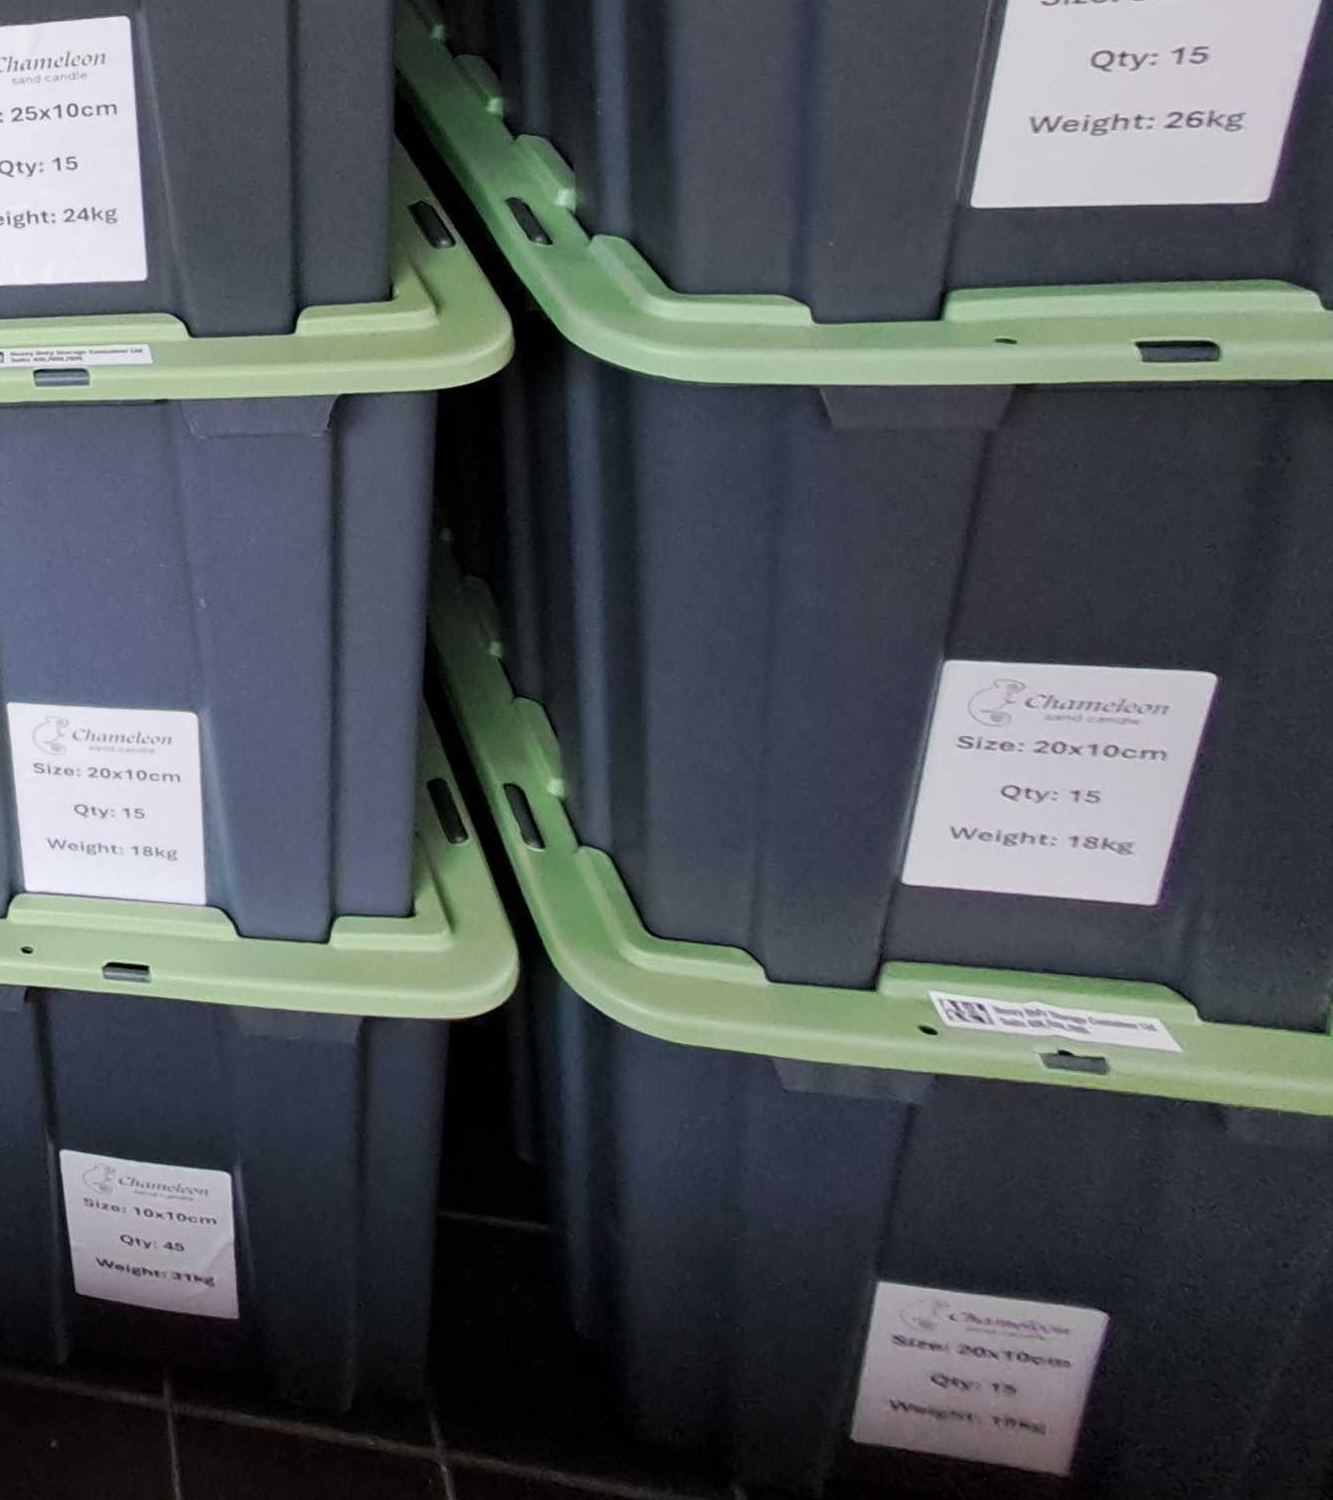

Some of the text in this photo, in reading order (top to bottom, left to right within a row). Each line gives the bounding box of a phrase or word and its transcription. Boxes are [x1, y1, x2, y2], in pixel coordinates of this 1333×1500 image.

[1090, 46, 1210, 72] Qty: 15
[11, 71, 88, 85] sand candle
[10, 103, 118, 123] 25x10cm
[1029, 110, 1246, 137] Weight: 26kg
[52, 157, 78, 172] 15
[63, 206, 118, 224] 24kg
[1025, 694, 1170, 717] Chameleon
[72, 728, 173, 746] Chameleon
[956, 735, 1168, 762] Size: 20x10cm
[33, 762, 182, 783] Size: 20x10cm
[1000, 784, 1102, 804] Qty: 15
[73, 804, 146, 820] Qty: 15
[47, 837, 178, 862] Weight: 18kg
[949, 825, 1135, 856] Weight: 18kg
[118, 1176, 209, 1197] Chameleon
[84, 1197, 217, 1226] Size: 10x10cm
[120, 1234, 185, 1252] Qty: 45
[95, 1257, 216, 1288] Weight: 31kg
